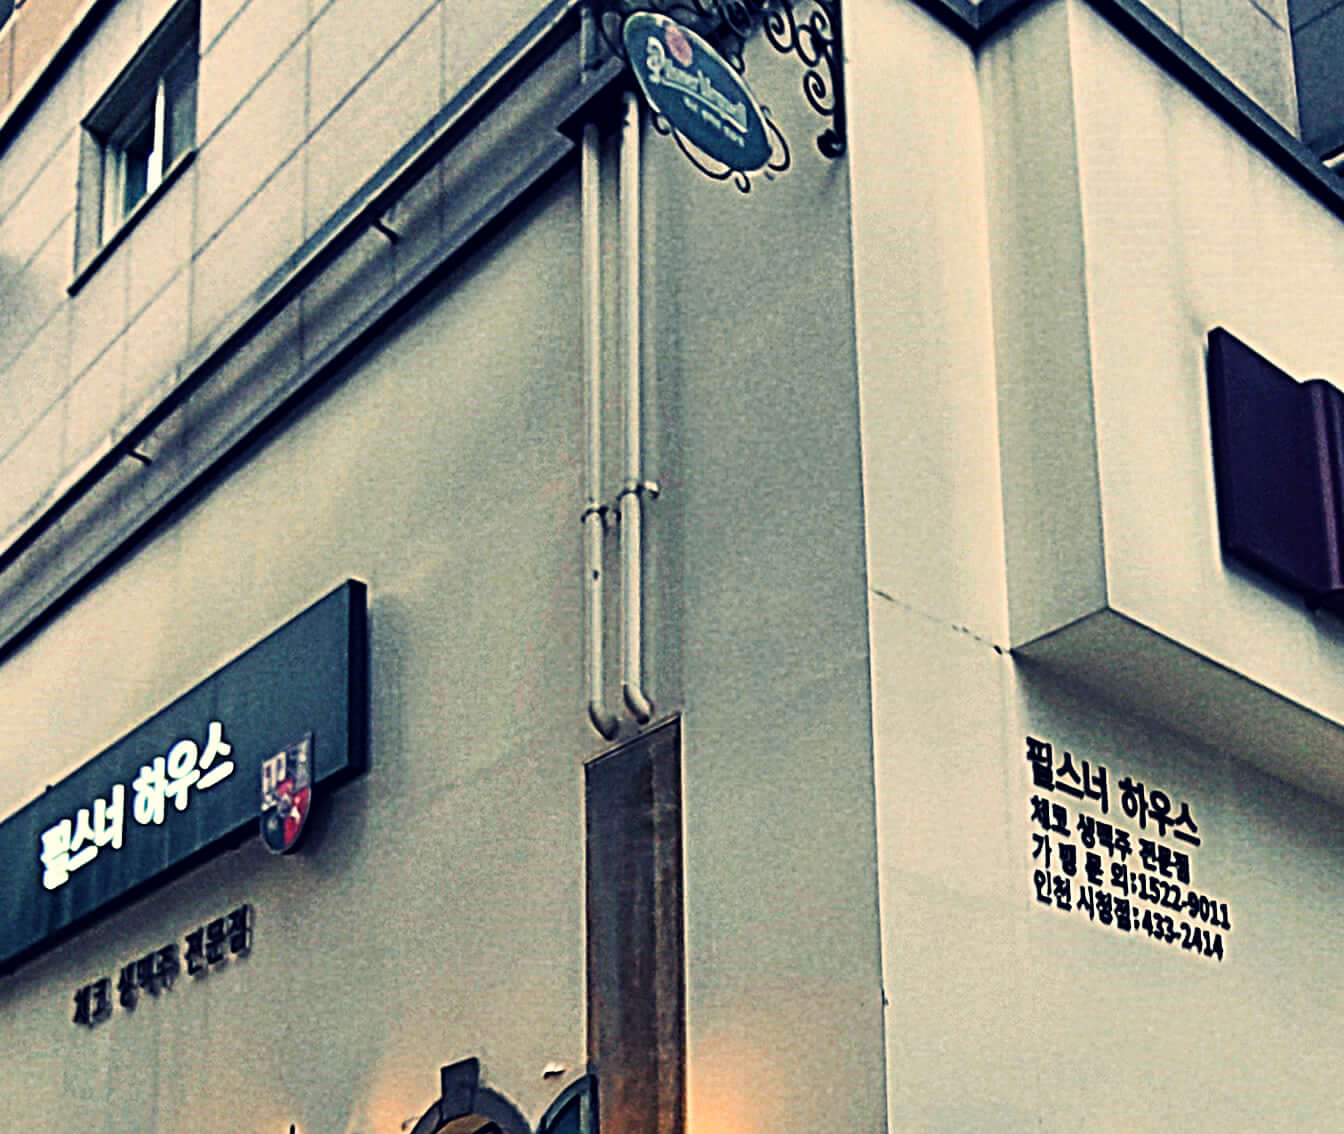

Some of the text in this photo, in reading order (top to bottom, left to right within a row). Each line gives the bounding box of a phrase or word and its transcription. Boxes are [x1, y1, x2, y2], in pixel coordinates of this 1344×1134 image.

[40, 720, 235, 891] 필스너 하우스
[1026, 736, 1201, 847] 필스너 하우스
[1033, 869, 1073, 911] 인천
